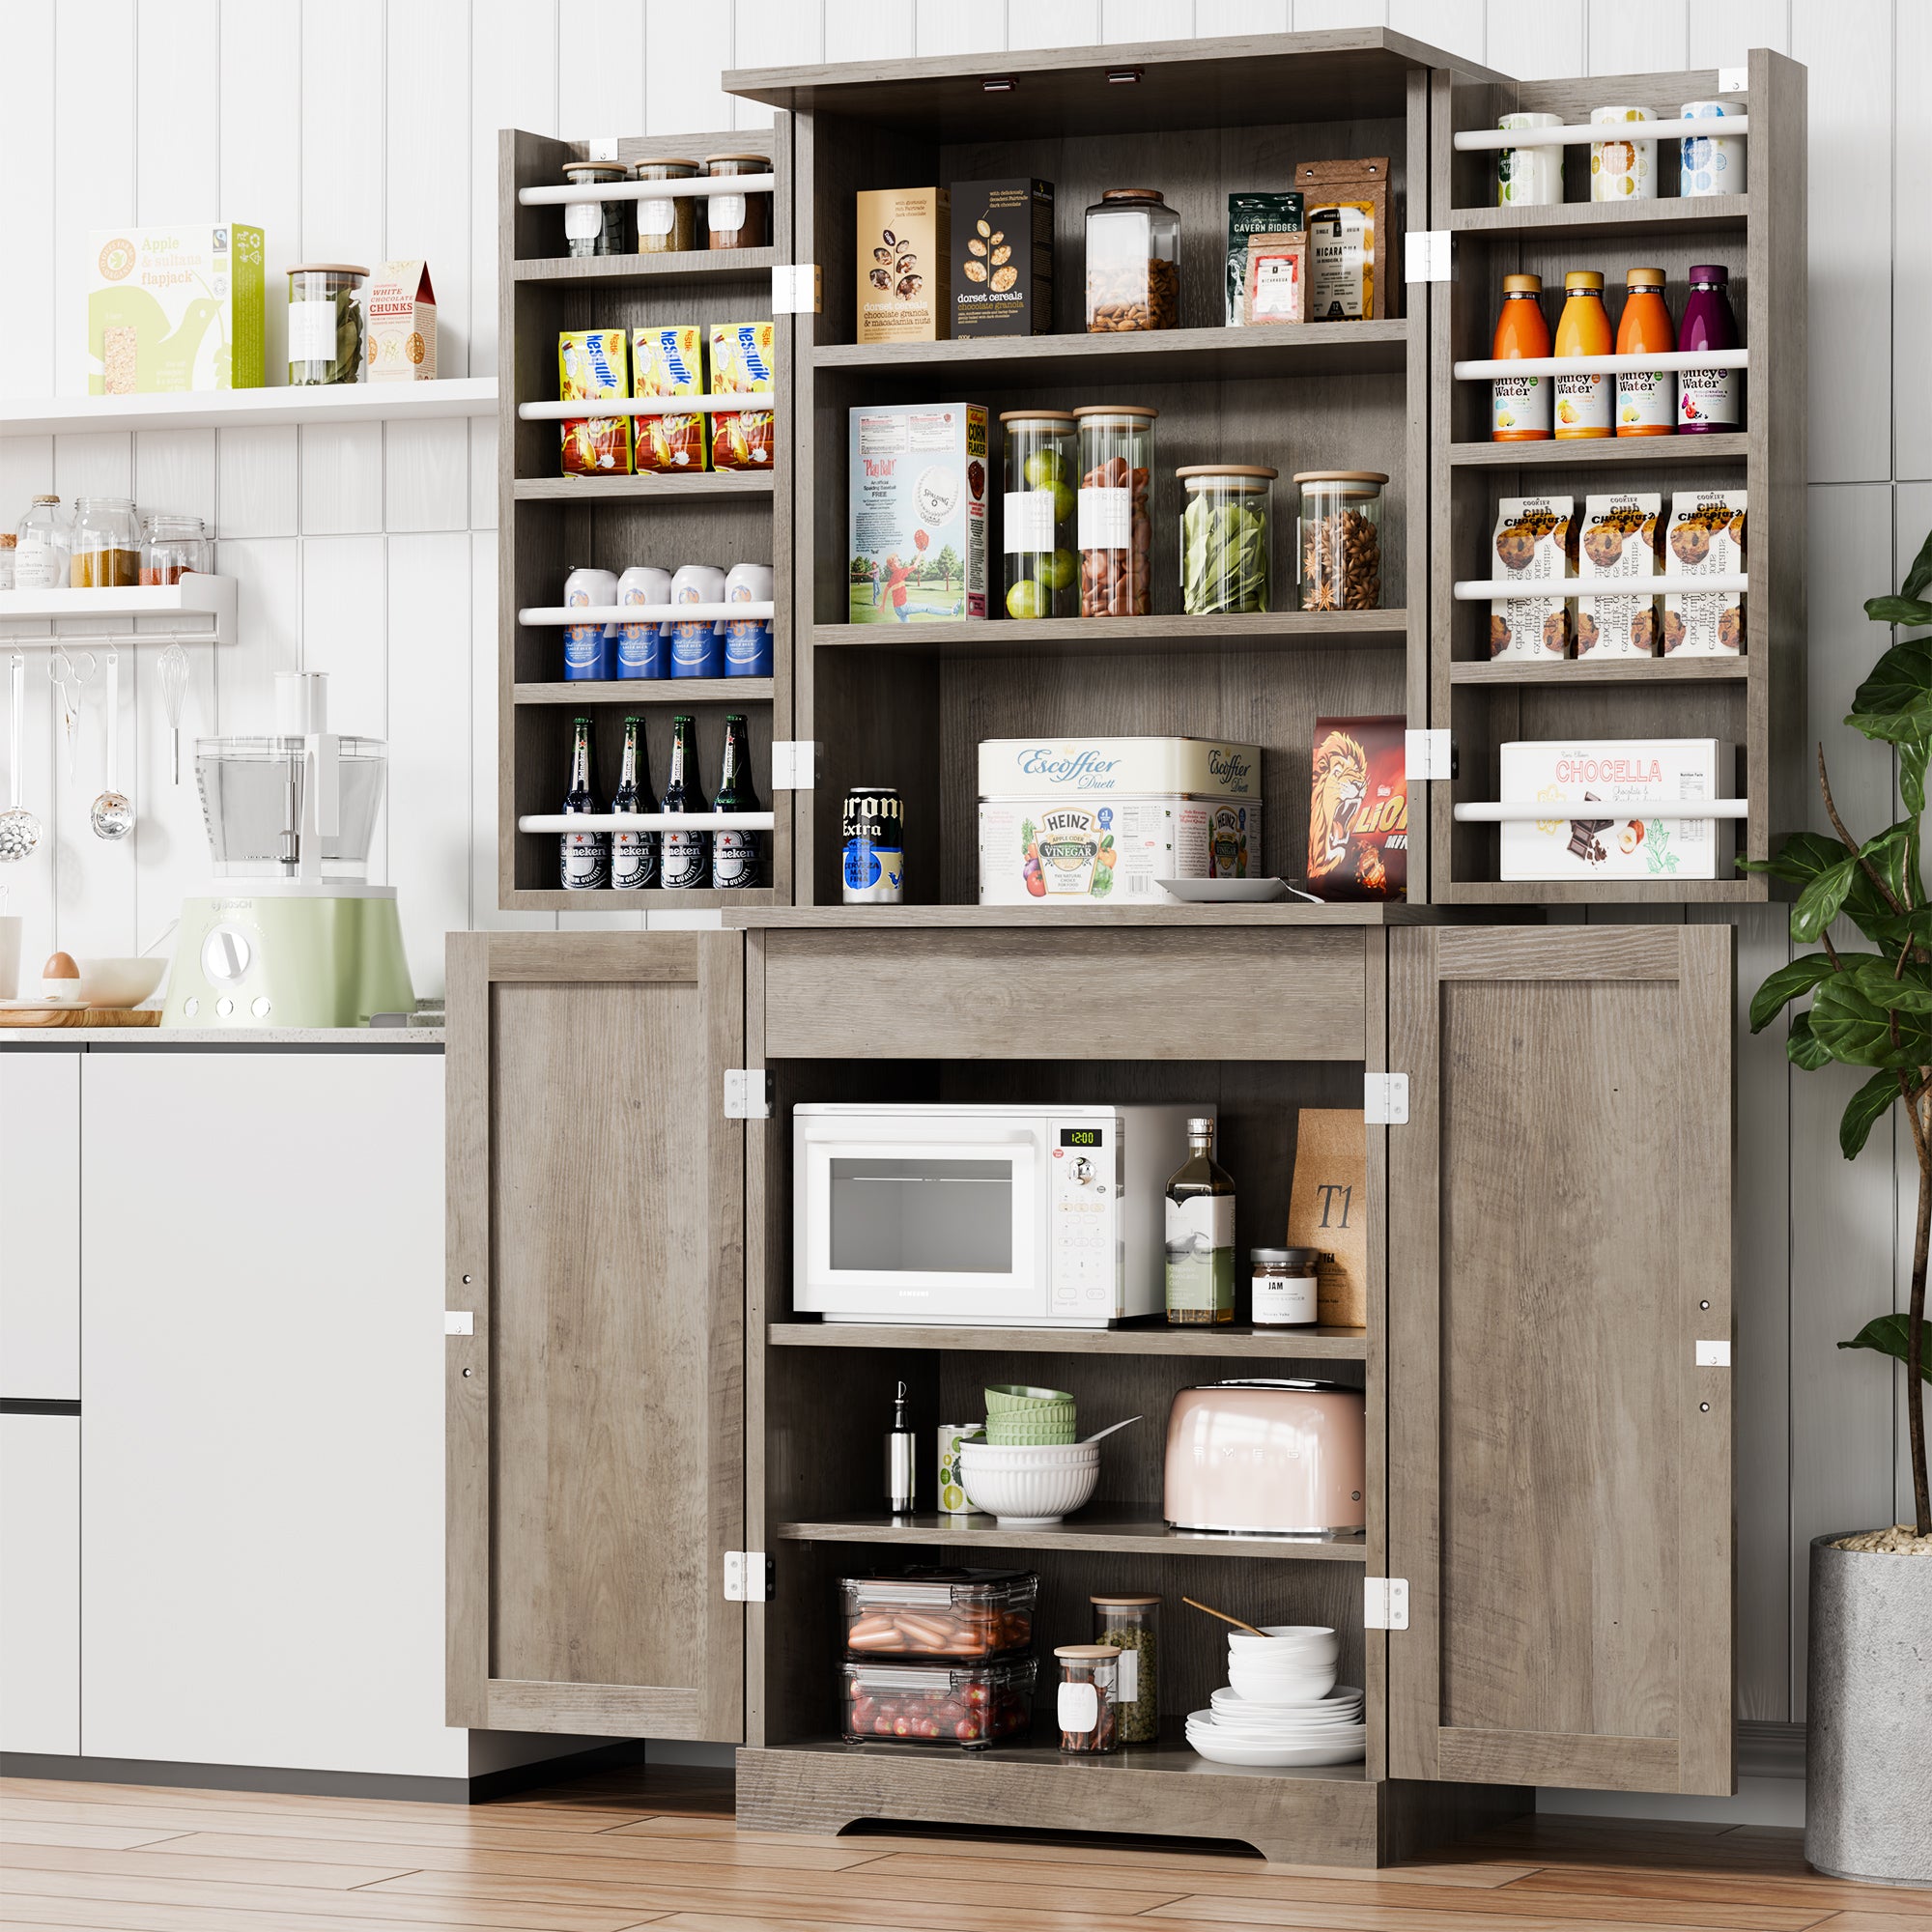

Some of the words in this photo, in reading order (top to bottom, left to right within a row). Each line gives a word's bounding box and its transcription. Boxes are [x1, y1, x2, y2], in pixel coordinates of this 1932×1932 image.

[1234, 223, 1265, 233] CAVERN
[1268, 223, 1297, 232] RIDGES
[141, 237, 180, 254] Apple
[155, 254, 202, 268] sultana
[141, 270, 192, 288] flapjack
[370, 295, 414, 303] CHOCOLATE
[957, 293, 988, 303] dorset
[988, 291, 1023, 301] cereals
[370, 302, 412, 313] CHUNKS
[864, 301, 893, 311] dorset
[895, 300, 927, 310] cereals
[957, 302, 994, 311] chocolate
[994, 300, 1025, 310] granola
[864, 310, 899, 320] chocolate
[899, 309, 929, 319] granola
[871, 318, 913, 327] macadamia
[915, 317, 931, 326] nuts
[586, 334, 618, 388] Nesquik
[660, 330, 693, 385] Nesquik
[738, 327, 771, 382] Nesquik
[1557, 384, 1593, 394] Water
[1619, 381, 1655, 392] Water
[1682, 378, 1719, 389] Water
[1494, 386, 1530, 397] Water
[968, 423, 985, 442] CORN
[968, 441, 985, 455] FLAKES
[923, 488, 950, 506] SPALDING
[1017, 749, 1122, 782] Escoffier
[1208, 749, 1252, 784] Escoffier
[1555, 759, 1662, 783] CHOCELLA
[1077, 774, 1118, 790] Duett
[1230, 777, 1248, 793] Duett
[843, 819, 882, 837] Extra
[1047, 813, 1090, 831] HEINZ
[1216, 812, 1236, 831] HEINZ
[1044, 847, 1092, 857] VINEGAR
[580, 866, 601, 883] QUALITY
[625, 865, 645, 883] QUALITY
[675, 865, 697, 883] QUALITY
[728, 867, 751, 885] QUALITY
[222, 900, 252, 910] BOSCH
[1071, 1132, 1094, 1144] 12:00
[1317, 1184, 1352, 1229] T1
[1322, 1252, 1335, 1264] TEA
[1268, 1281, 1283, 1291] JAM
[1192, 1445, 1300, 1460] SMEG
